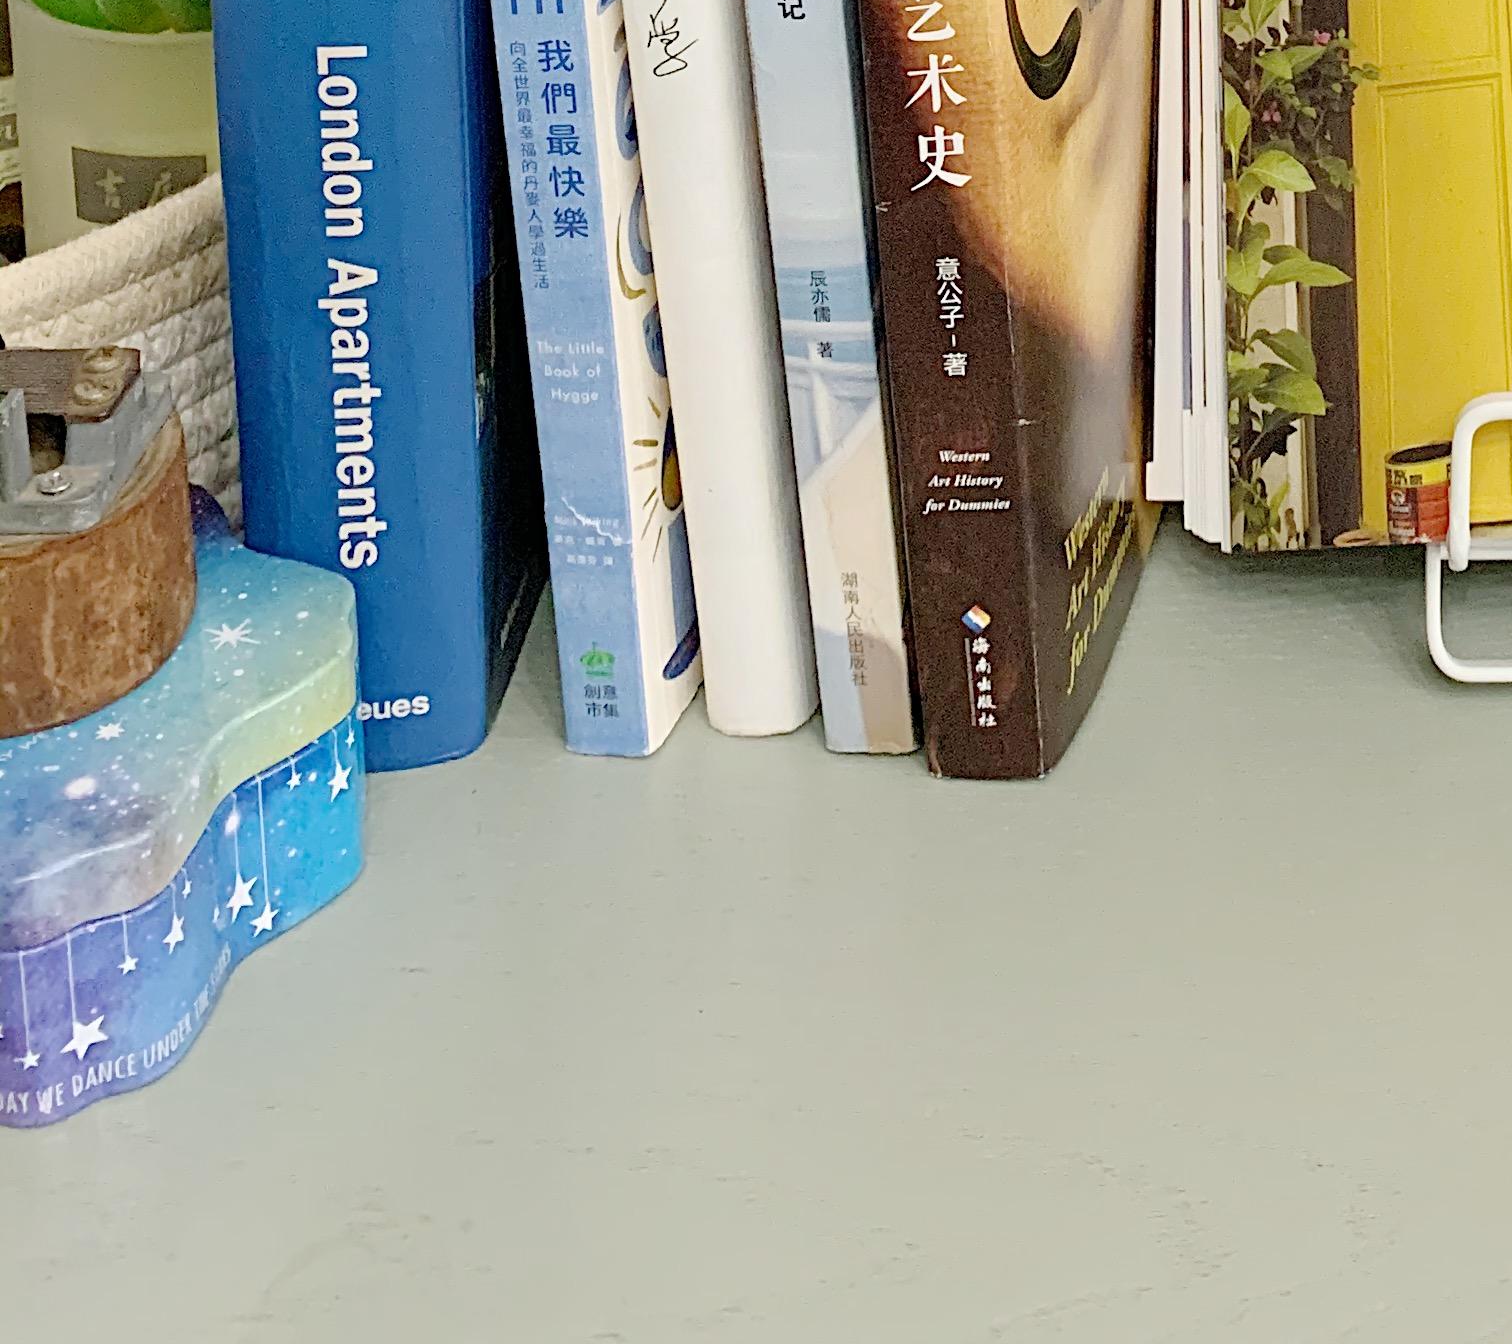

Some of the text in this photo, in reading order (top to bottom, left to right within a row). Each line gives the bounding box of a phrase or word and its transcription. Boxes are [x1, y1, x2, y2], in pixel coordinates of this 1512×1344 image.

[537, 39, 589, 240] 我們最快樂
[315, 44, 389, 570] London Apartments
[810, 270, 834, 359] 辰亦儒 著
[544, 363, 580, 378] Book
[551, 388, 599, 405] Hygge
[939, 450, 991, 463] Western
[928, 474, 1004, 490] Art History
[922, 498, 1011, 515] for Dummies
[35, 1082, 65, 1115] WE
[71, 1053, 138, 1097] DANCE
[143, 1013, 192, 1069] UNDER
